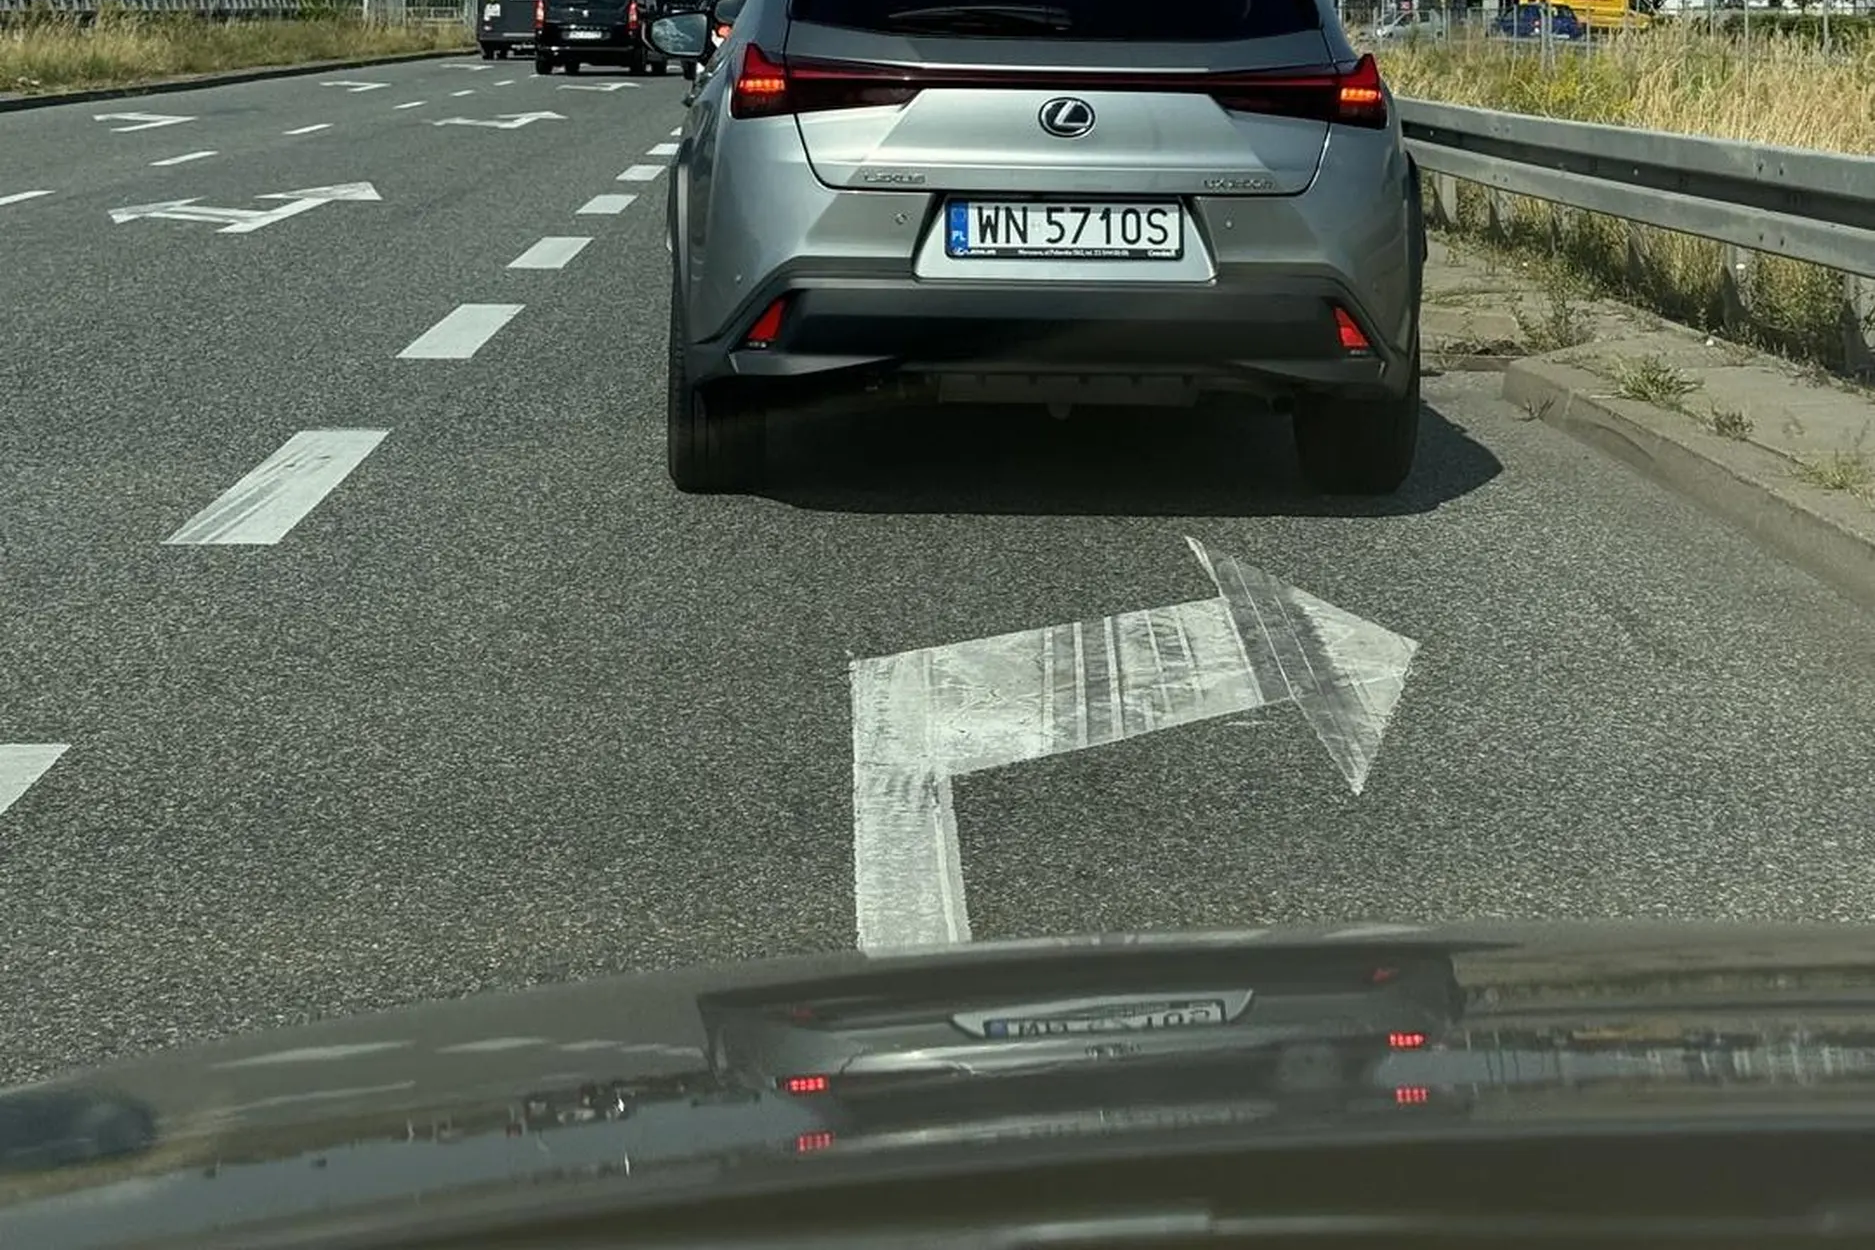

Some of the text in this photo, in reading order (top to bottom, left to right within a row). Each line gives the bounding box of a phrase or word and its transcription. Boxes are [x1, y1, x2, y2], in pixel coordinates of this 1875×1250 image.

[864, 172, 927, 184] LEXUS
[977, 206, 1169, 245] WN 5710S
[952, 230, 966, 241] PL
